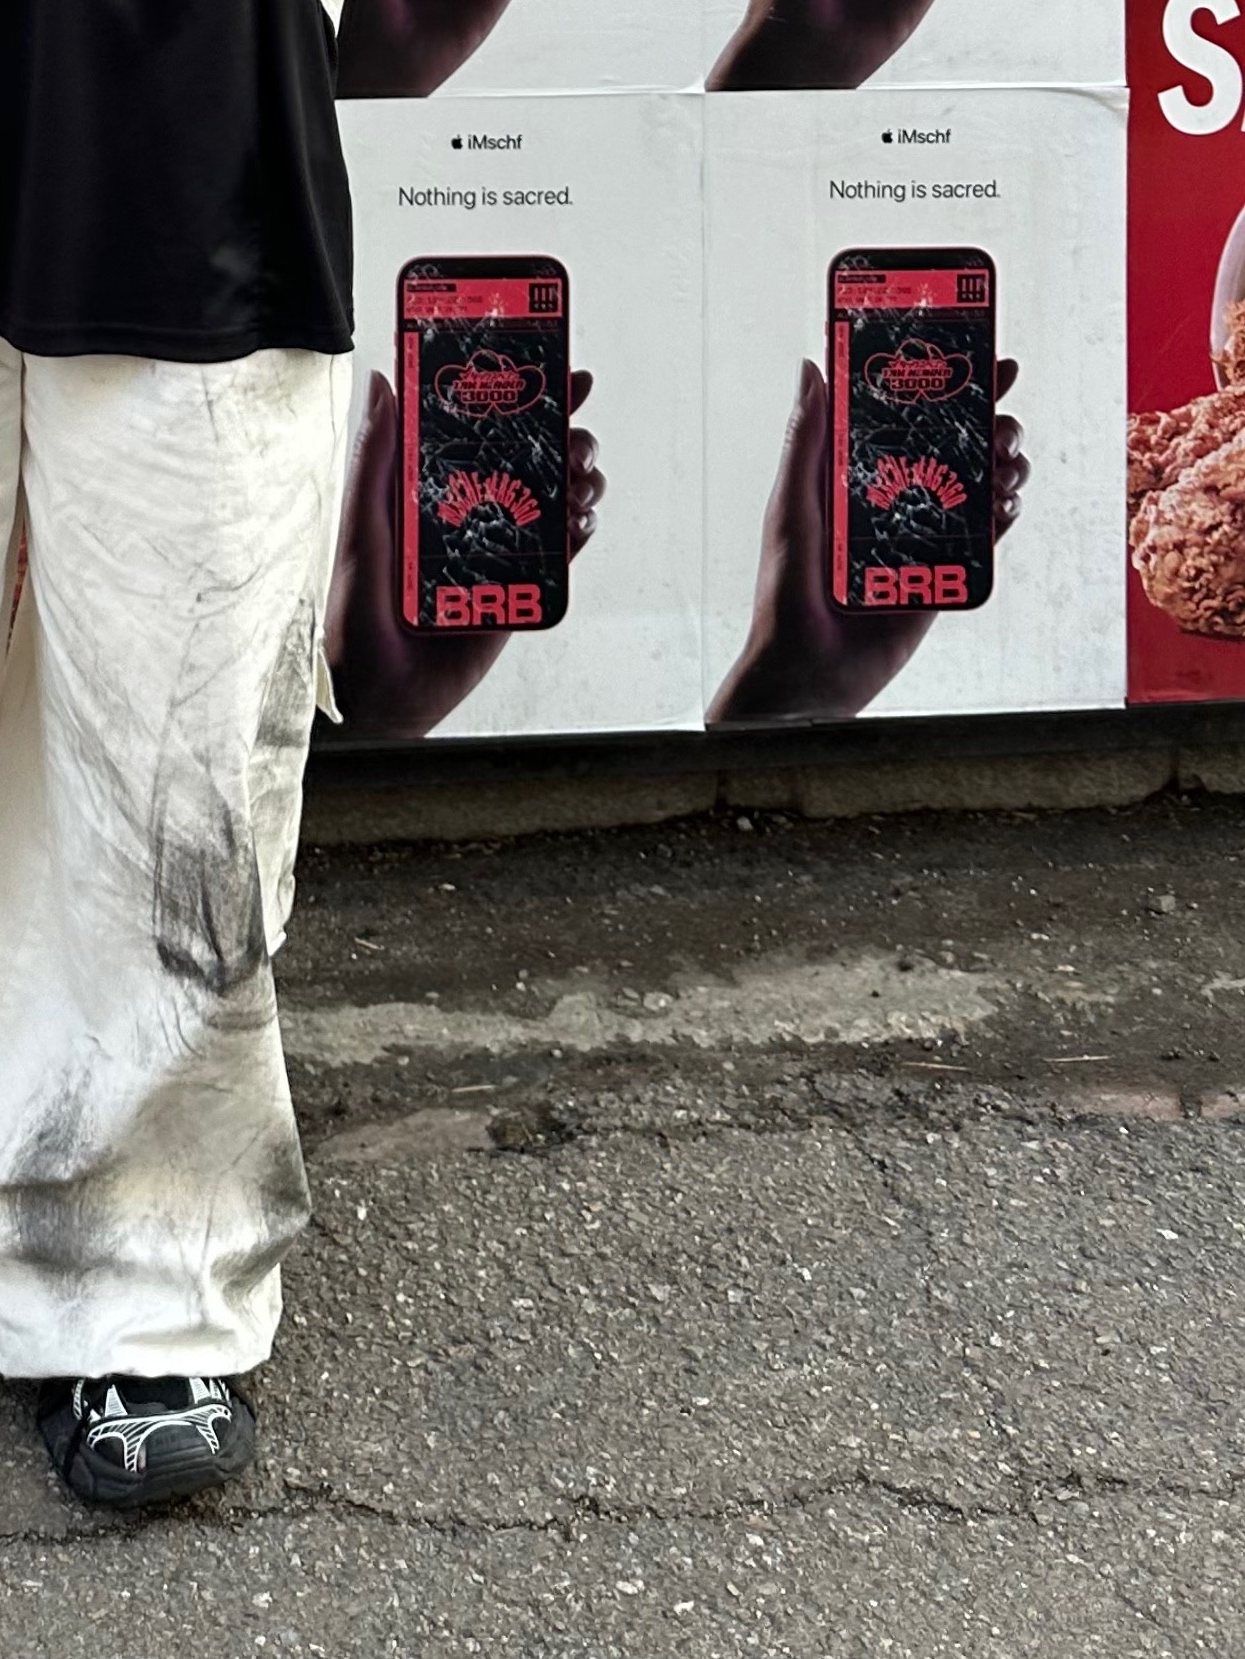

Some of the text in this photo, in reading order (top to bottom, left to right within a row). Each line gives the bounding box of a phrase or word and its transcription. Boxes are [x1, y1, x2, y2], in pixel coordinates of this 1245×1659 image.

[467, 134, 523, 150] iMschf
[897, 128, 951, 144] iMschf
[398, 186, 574, 210] Nothing is sacred.
[829, 179, 1001, 203] Nothing is sacred.
[865, 565, 967, 606] BRB
[436, 585, 541, 626] BRB
